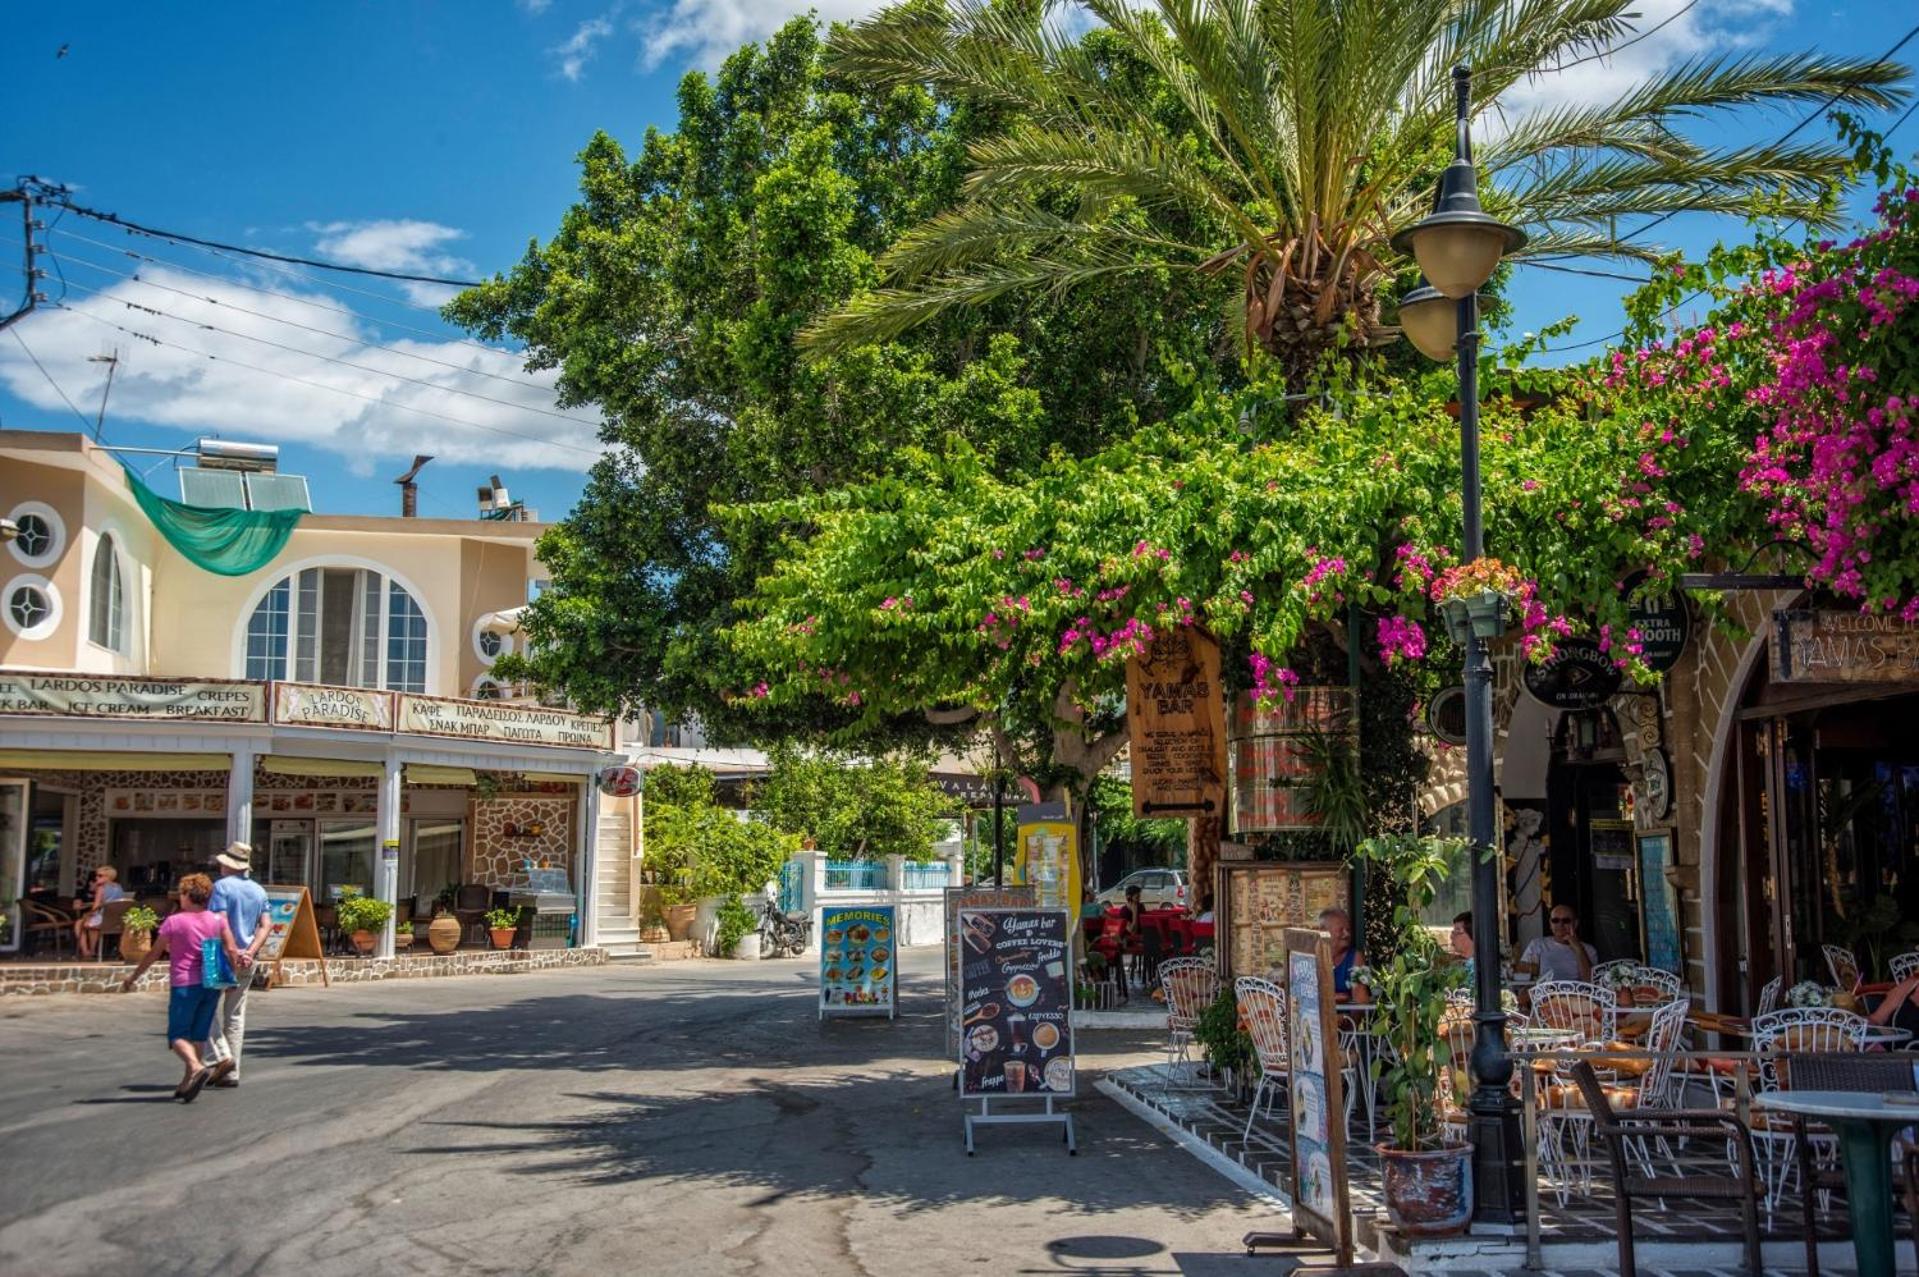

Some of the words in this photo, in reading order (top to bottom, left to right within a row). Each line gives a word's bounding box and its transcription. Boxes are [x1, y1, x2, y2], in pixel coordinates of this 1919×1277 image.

[1635, 618, 1670, 628] EXTRA
[1823, 615, 1899, 633] WELCOME
[1638, 628, 1681, 643] OOTH
[1797, 634, 1886, 670] YAMAS
[30, 679, 102, 693] LARDOS
[106, 681, 187, 696] PARADISE
[197, 690, 250, 702] CREPES
[310, 690, 364, 707] LARDOS
[1139, 682, 1209, 699] YAMAS
[0, 699, 14, 710] K
[17, 699, 50, 710] BAR
[67, 701, 92, 713] ICE
[96, 702, 151, 715] CREAM
[165, 704, 249, 717] BREAKFAST
[302, 703, 370, 722] PARADISE
[1157, 699, 1194, 715] BAR
[412, 703, 442, 717] ΚΑΦΕ
[457, 705, 523, 722] ΠΑΡΑΔΕΙΣΟΣ
[526, 712, 566, 726] ΛΑΡΔΟΥ
[571, 720, 603, 733] ΚΡΕΠΕΣ
[429, 719, 458, 732] ΣΝΑΚ
[460, 722, 489, 735] ΜΠΑΡ
[503, 726, 542, 739] ΠΑΓΩΤΑ
[825, 910, 890, 926] MEMORIES
[996, 938, 1028, 949] COFFEE
